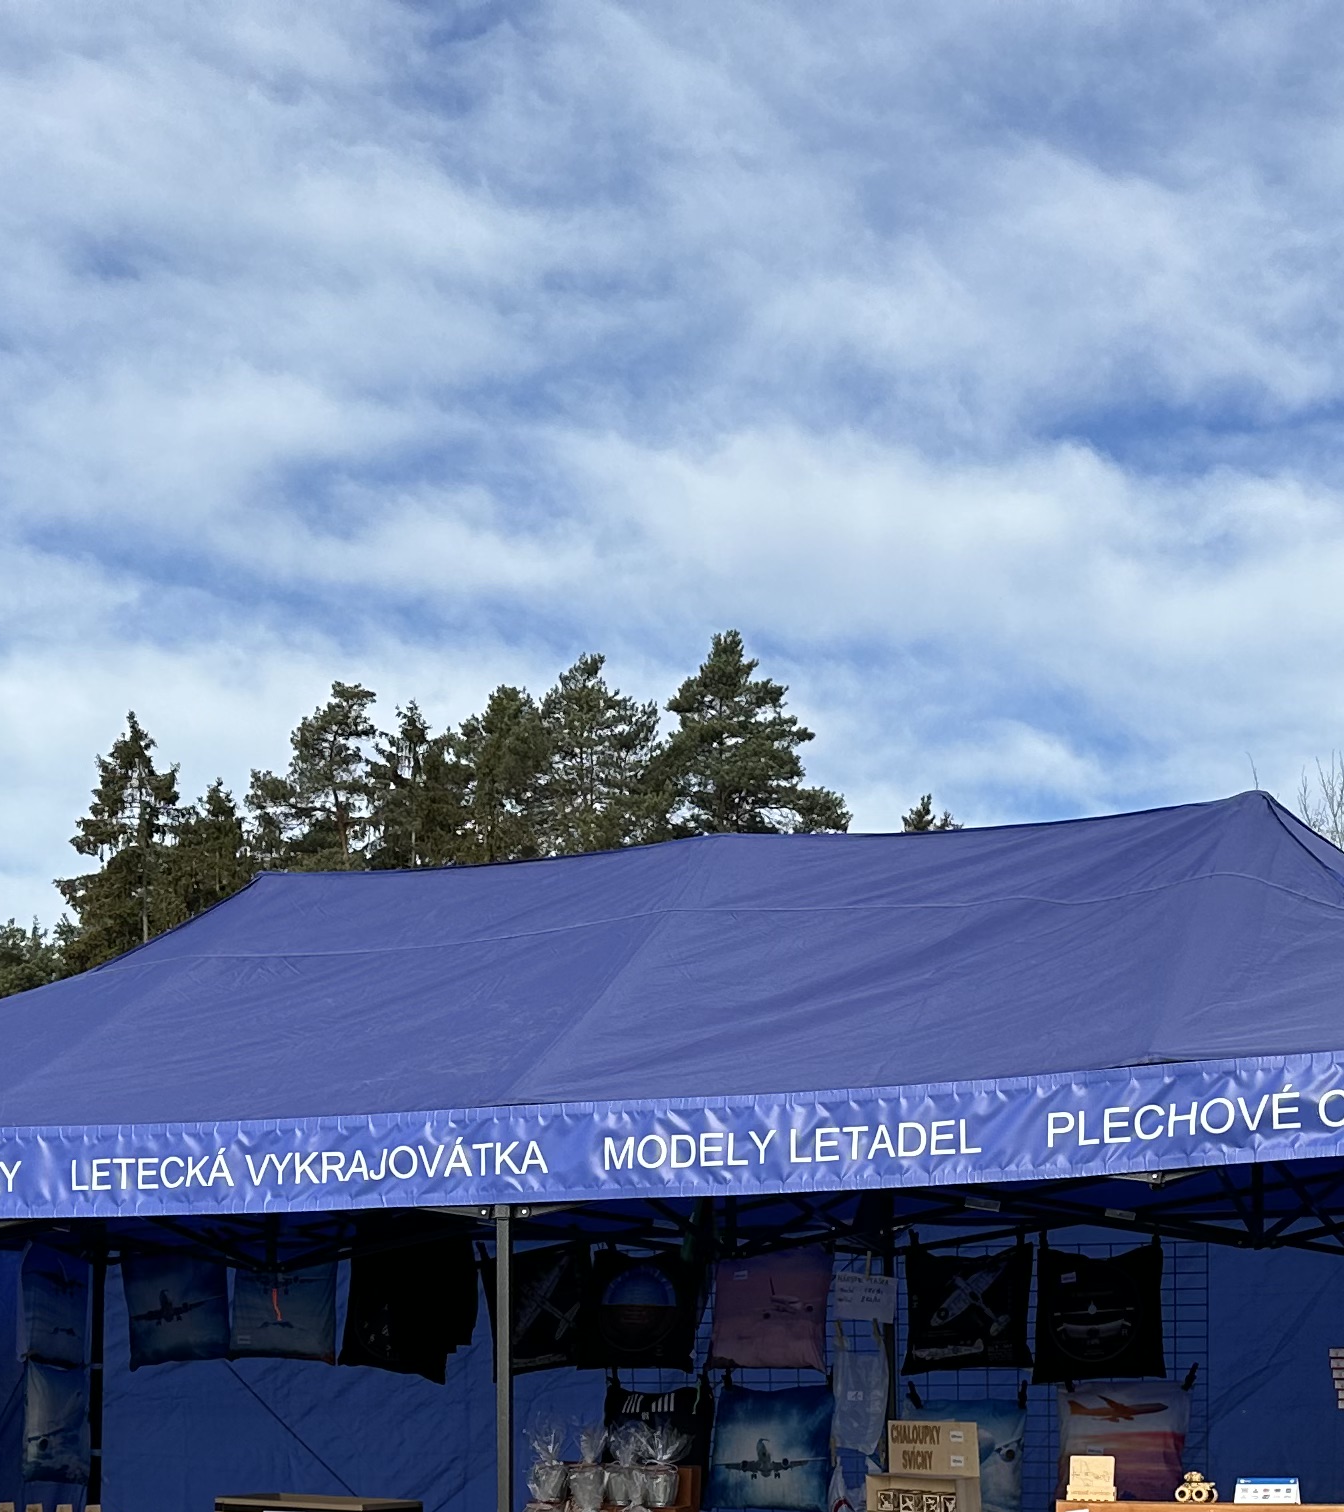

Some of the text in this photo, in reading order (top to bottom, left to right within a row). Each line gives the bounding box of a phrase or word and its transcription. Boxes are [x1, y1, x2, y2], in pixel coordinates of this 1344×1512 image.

[1046, 1083, 1301, 1148] PLECHOVÉ
[71, 1136, 549, 1191] LETECKÁ VYKRAJOVÁTKA
[603, 1119, 982, 1170] MODELY LETADEL
[890, 1424, 941, 1445] CHALOUPKY
